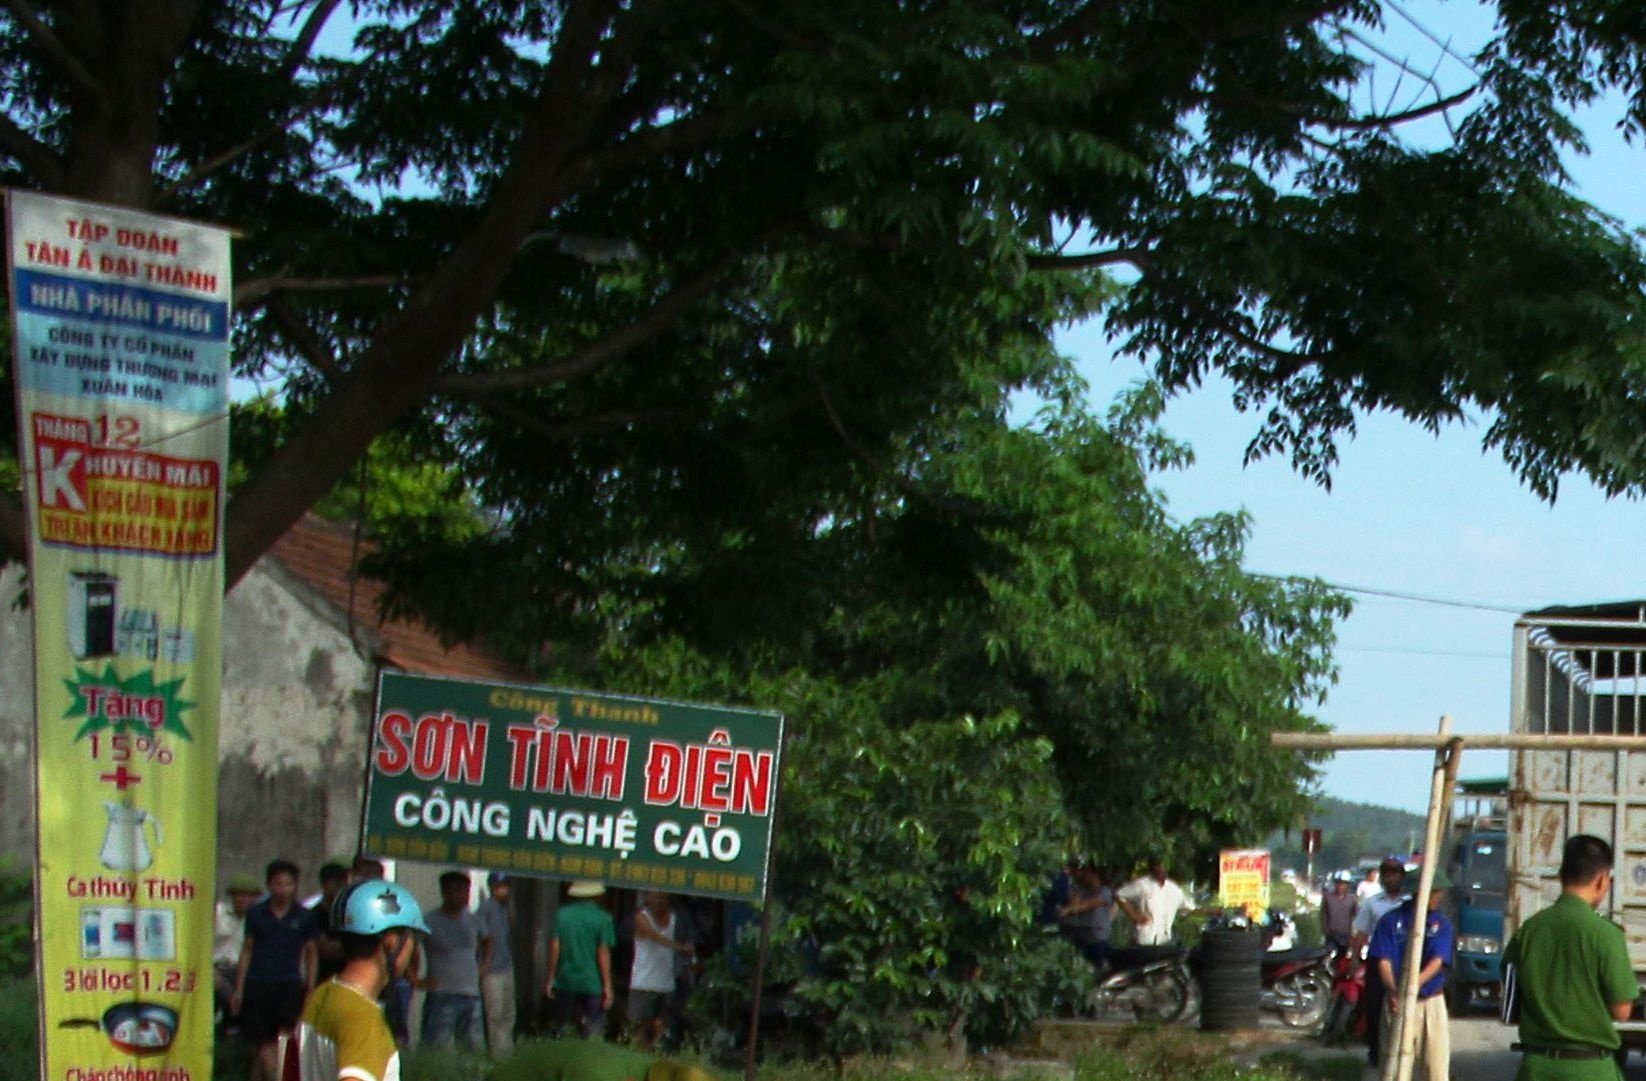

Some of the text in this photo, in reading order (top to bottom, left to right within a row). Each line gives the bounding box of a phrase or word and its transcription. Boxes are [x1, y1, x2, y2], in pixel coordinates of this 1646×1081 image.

[375, 711, 774, 828] SƠN TĨNH ĐIỆN
[394, 788, 742, 862] CÔNG NGHỆ CAO
